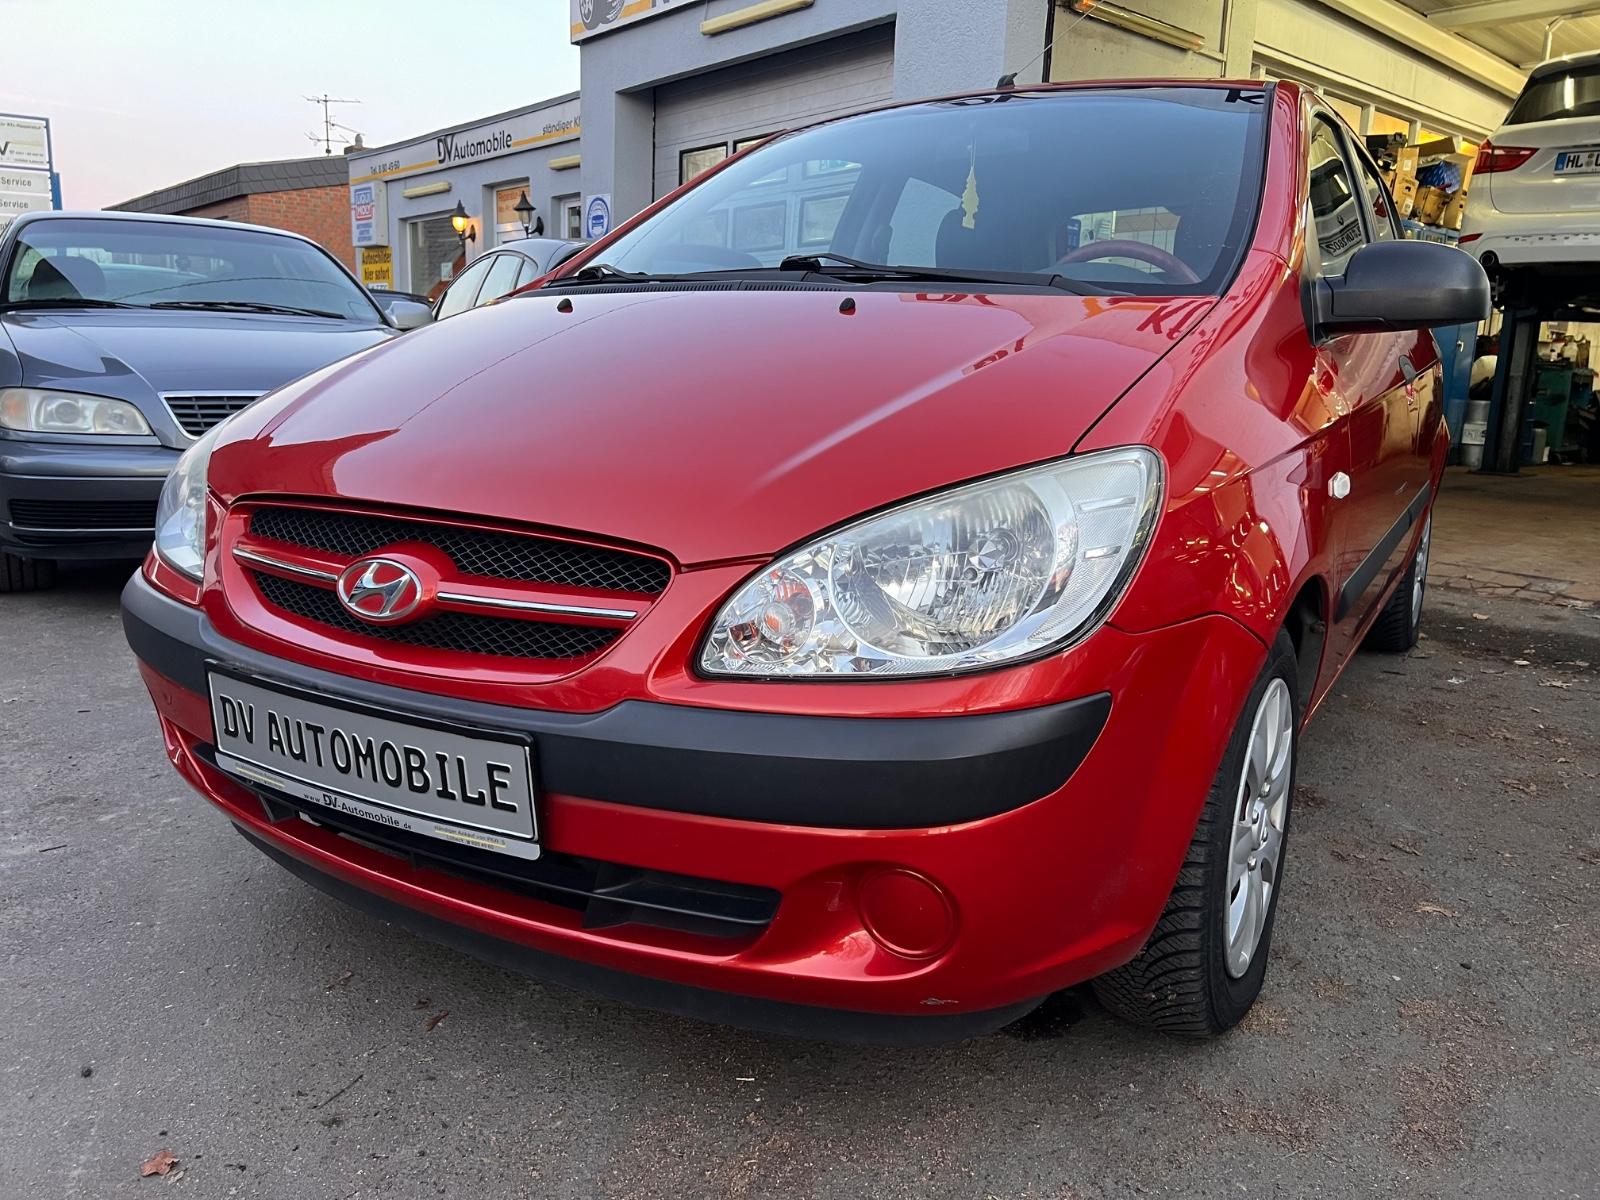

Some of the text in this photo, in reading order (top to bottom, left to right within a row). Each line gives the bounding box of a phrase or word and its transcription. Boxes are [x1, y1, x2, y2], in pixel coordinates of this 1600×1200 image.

[453, 130, 512, 161] Automobile
[1566, 154, 1583, 168] HL
[1, 176, 32, 187] Service
[219, 695, 518, 813] DV AUTOMOBILE
